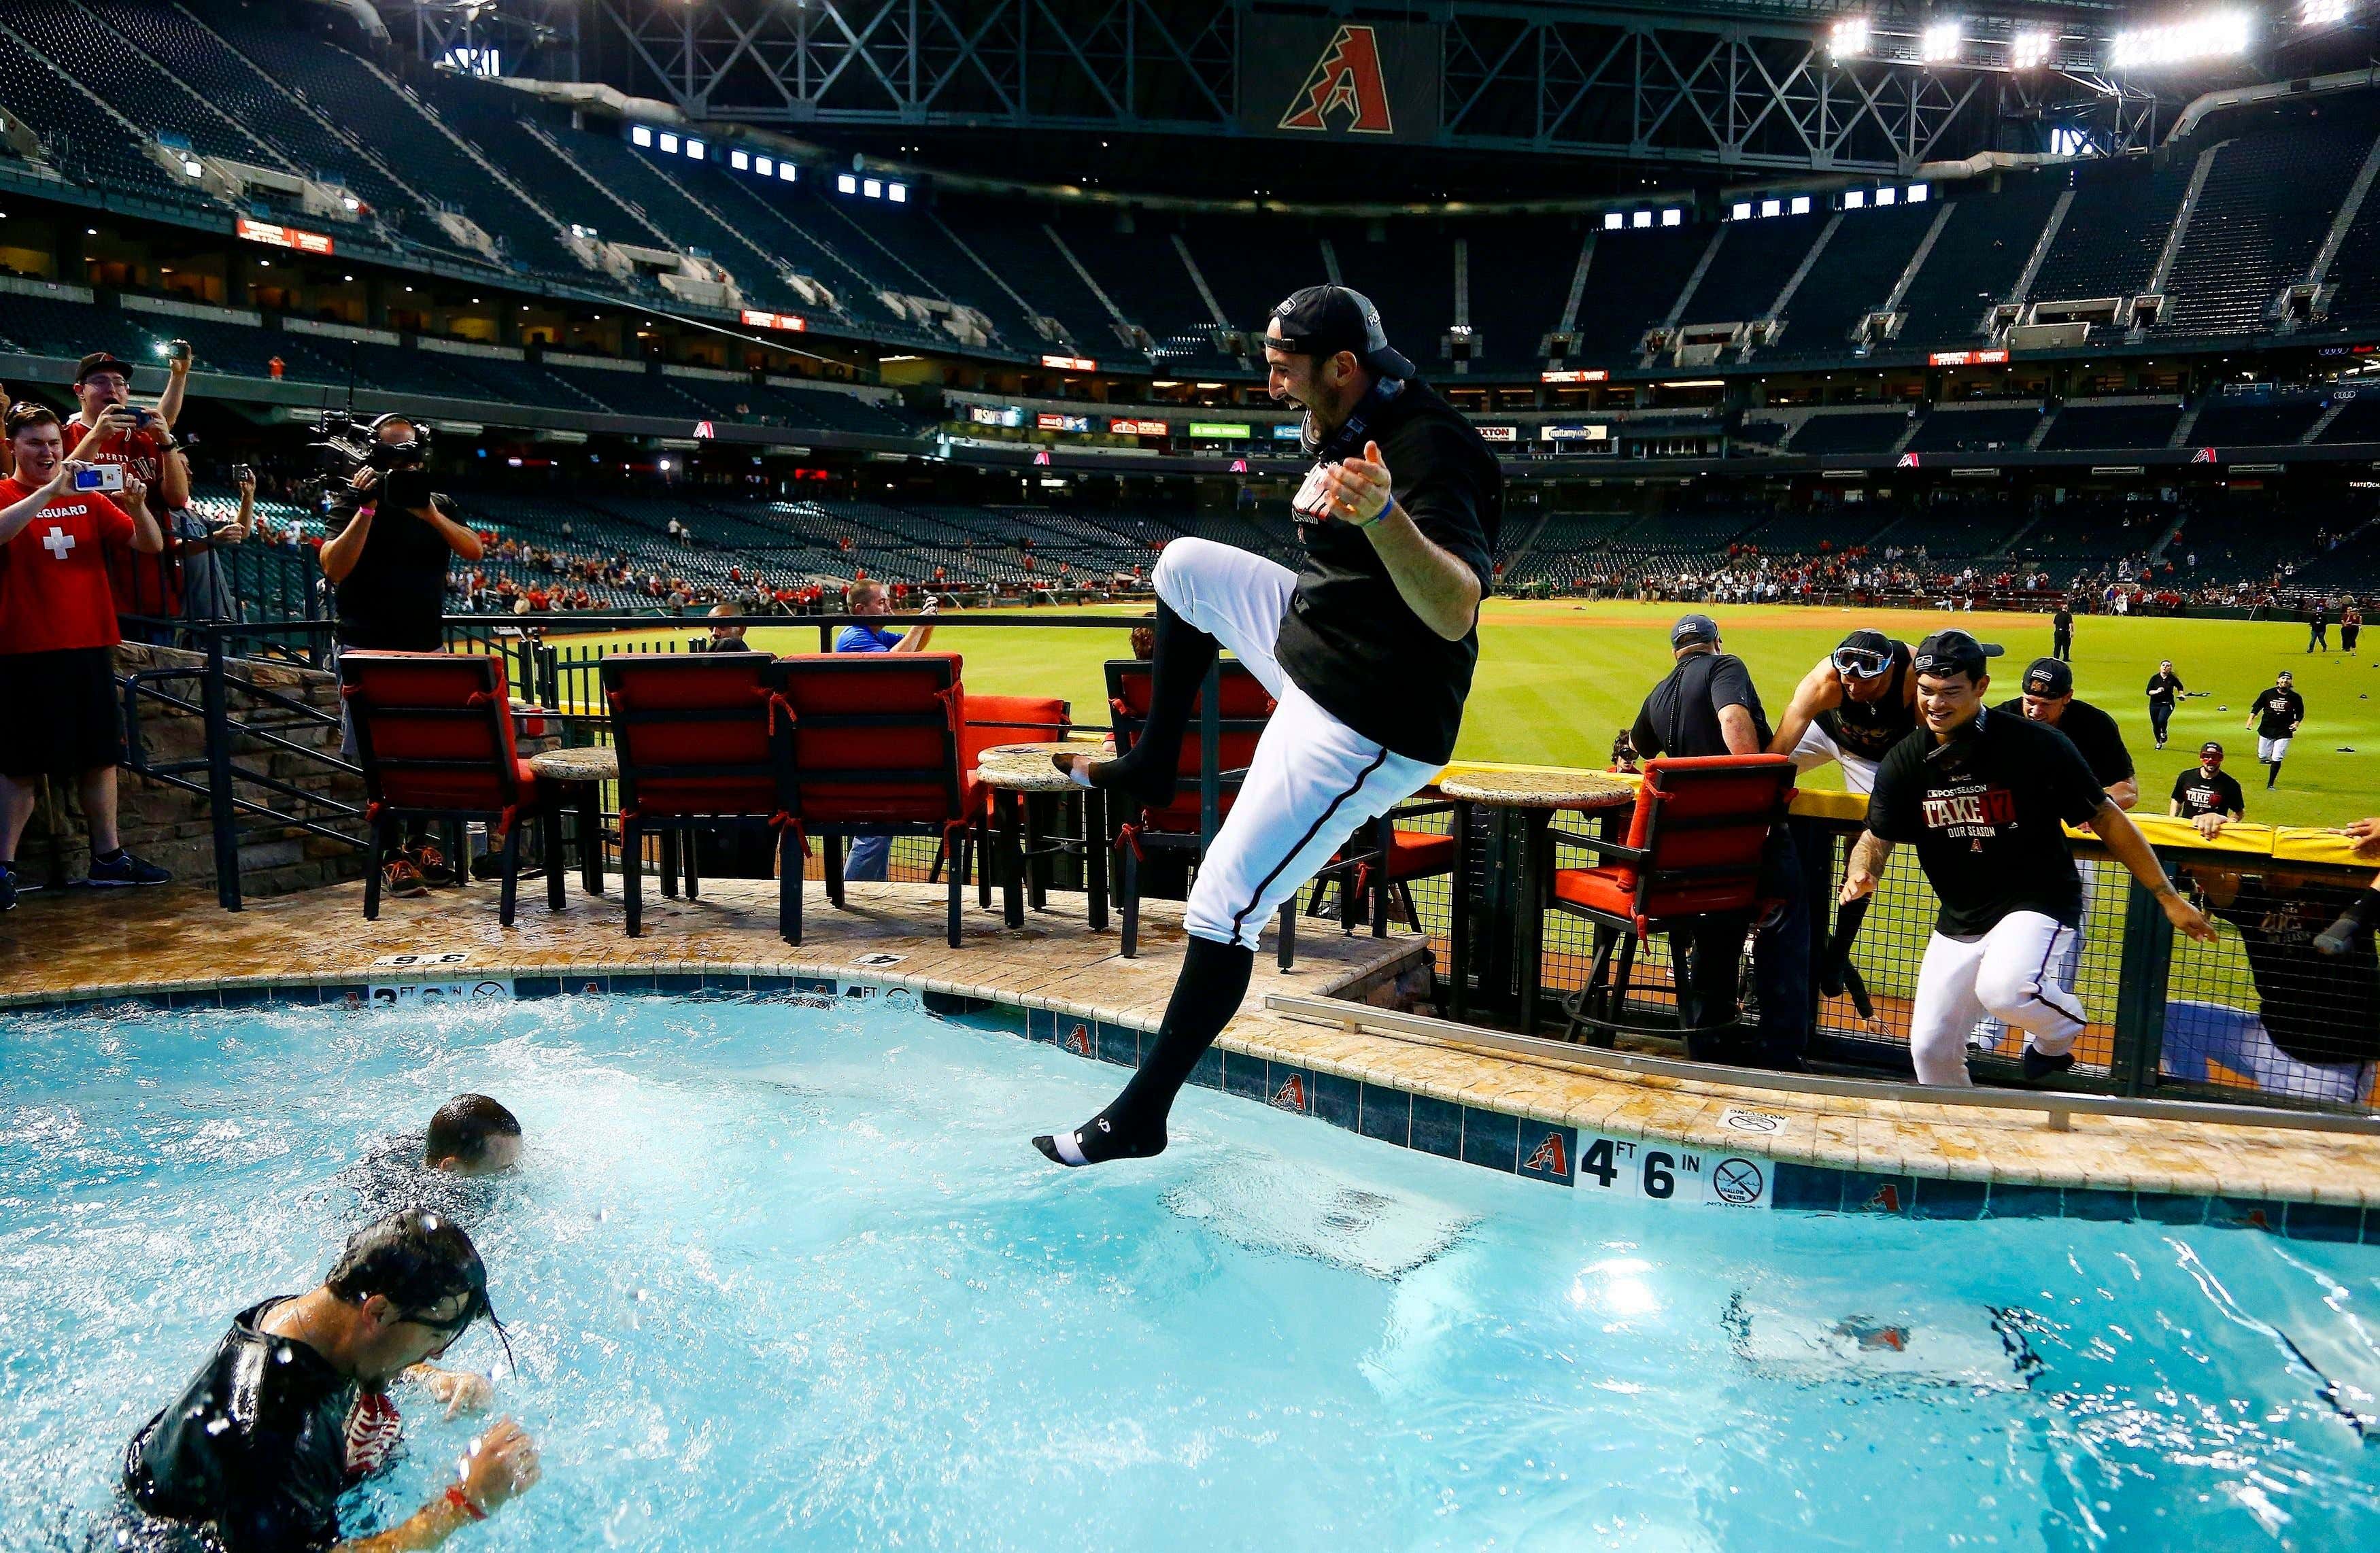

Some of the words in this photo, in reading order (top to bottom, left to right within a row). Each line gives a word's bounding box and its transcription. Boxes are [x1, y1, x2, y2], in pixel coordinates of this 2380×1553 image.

[95, 452, 129, 462] OPERTY
[1938, 784, 1987, 797] POSTSEASON
[2186, 789, 2211, 804] TAKE
[1922, 796, 1985, 828] TAKE
[1948, 827, 1967, 838] OUR
[1967, 825, 1996, 837] SEASON
[400, 986, 418, 997] FT
[864, 986, 878, 998] FT
[1581, 1138, 1618, 1188] 4
[1616, 1140, 1637, 1159] FT
[1644, 1150, 1676, 1199] 6
[1682, 1153, 1700, 1173] IN
[1720, 1187, 1744, 1195] SHALLOW
[1727, 1193, 1747, 1201] WATER
